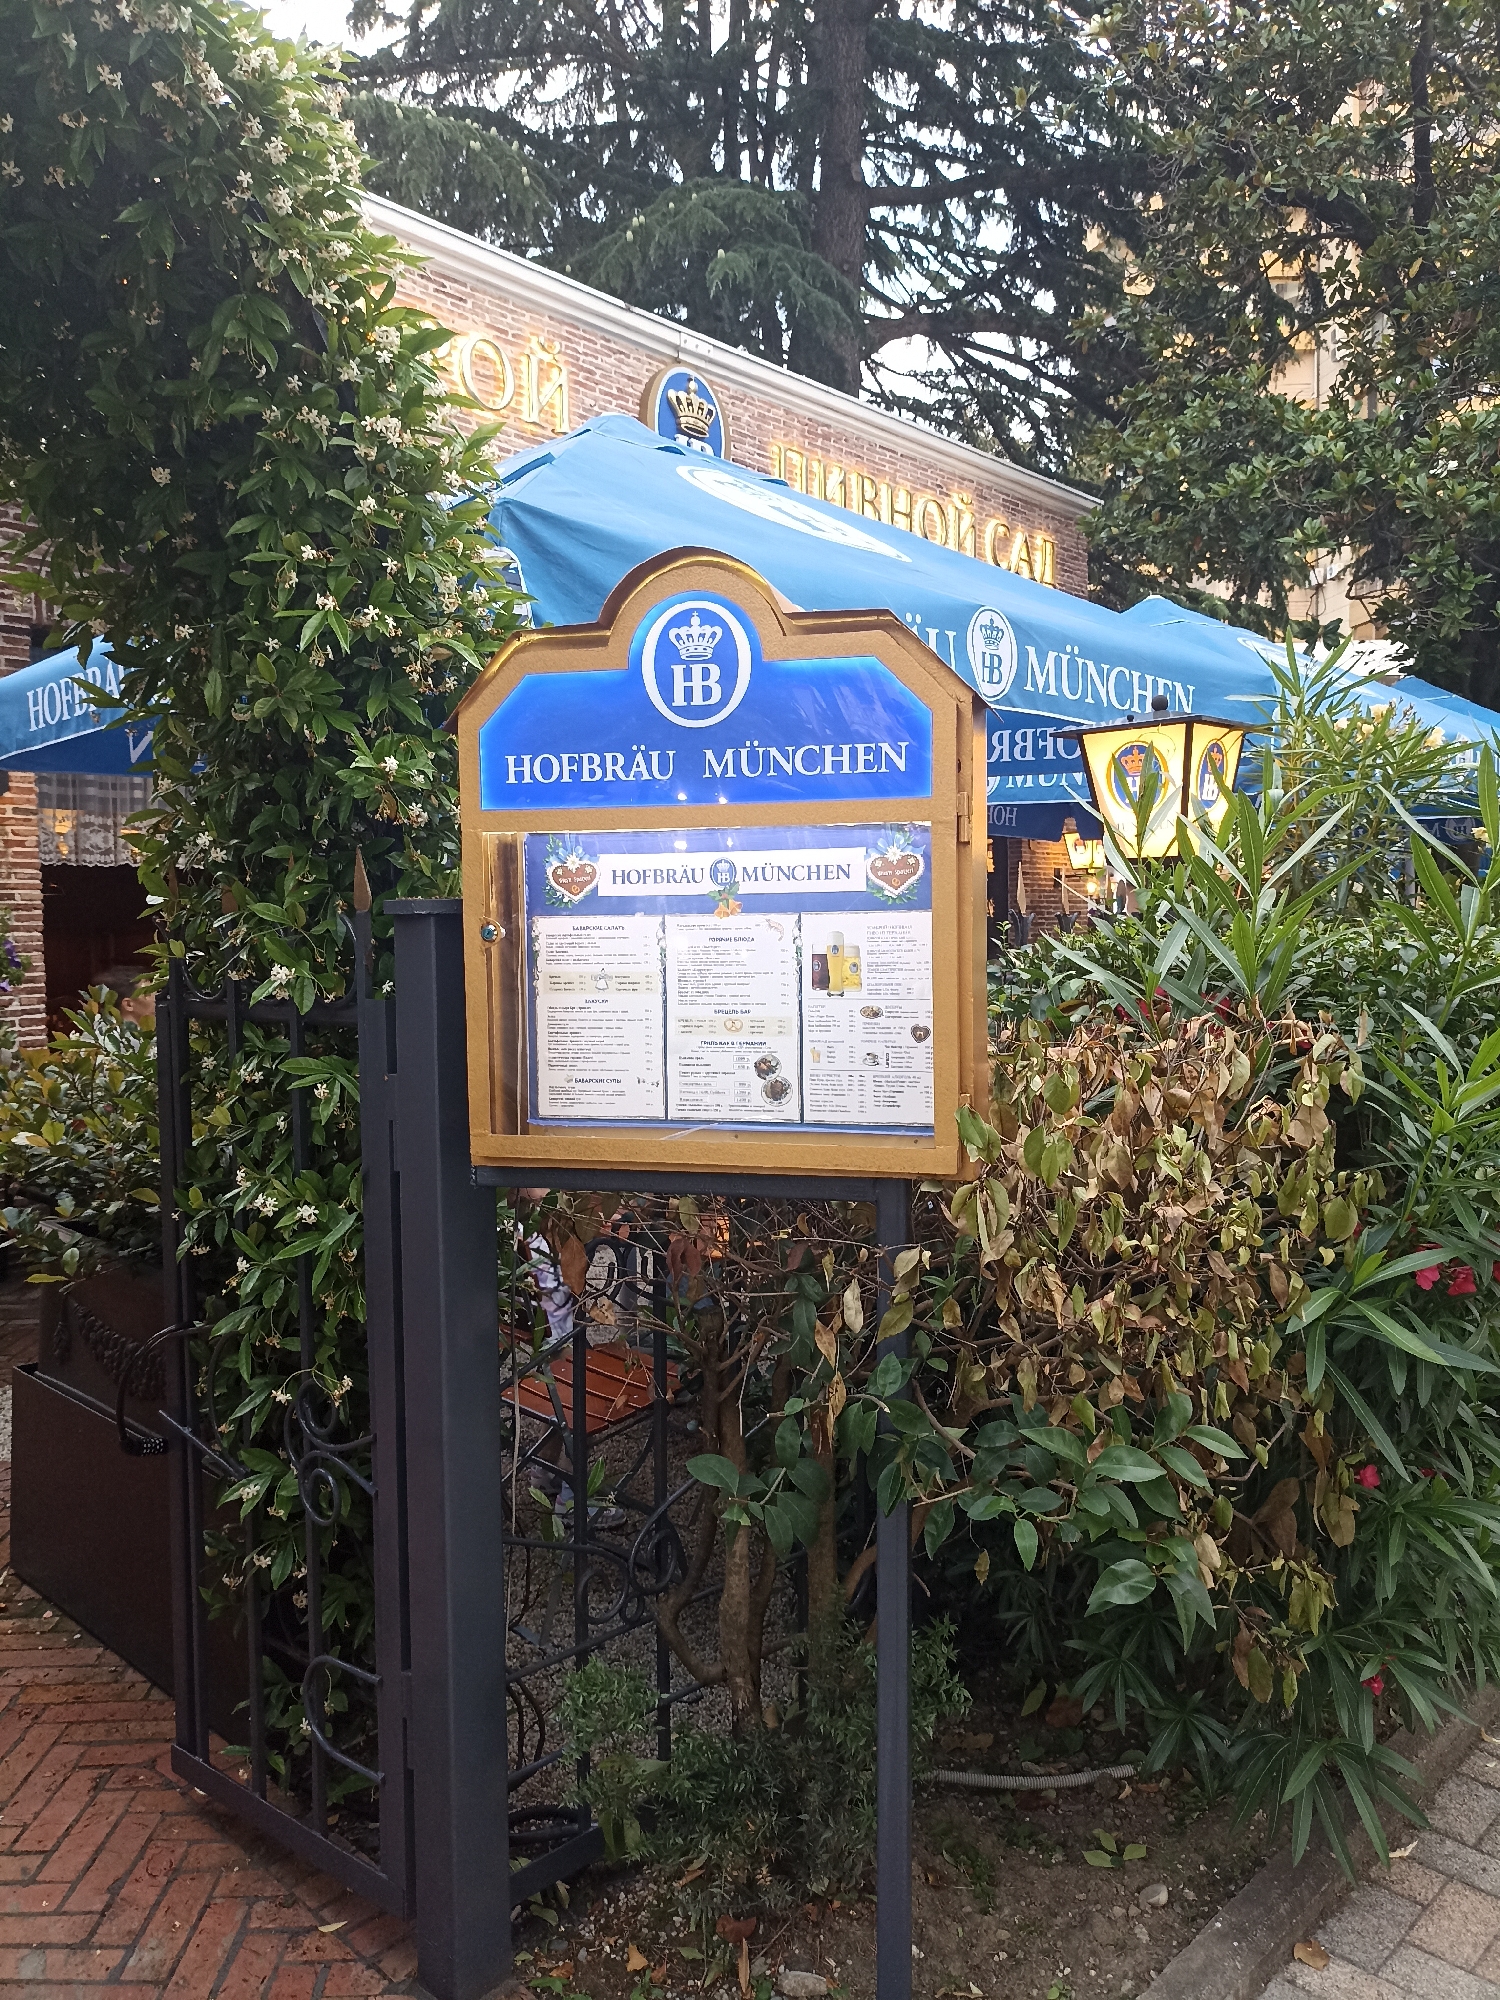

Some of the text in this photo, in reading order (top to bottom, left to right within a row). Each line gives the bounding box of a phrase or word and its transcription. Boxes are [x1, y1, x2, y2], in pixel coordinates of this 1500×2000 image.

[770, 444, 1058, 588] ПИВНОЙ САД
[671, 663, 723, 707] HB
[982, 651, 1003, 685] HB
[1023, 644, 1196, 713] MÜNCHEN
[505, 740, 910, 784] HOFBRÄU MÜNCHEN
[611, 864, 705, 885] HOFBRÄU
[742, 862, 851, 882] MÜNCHEN
